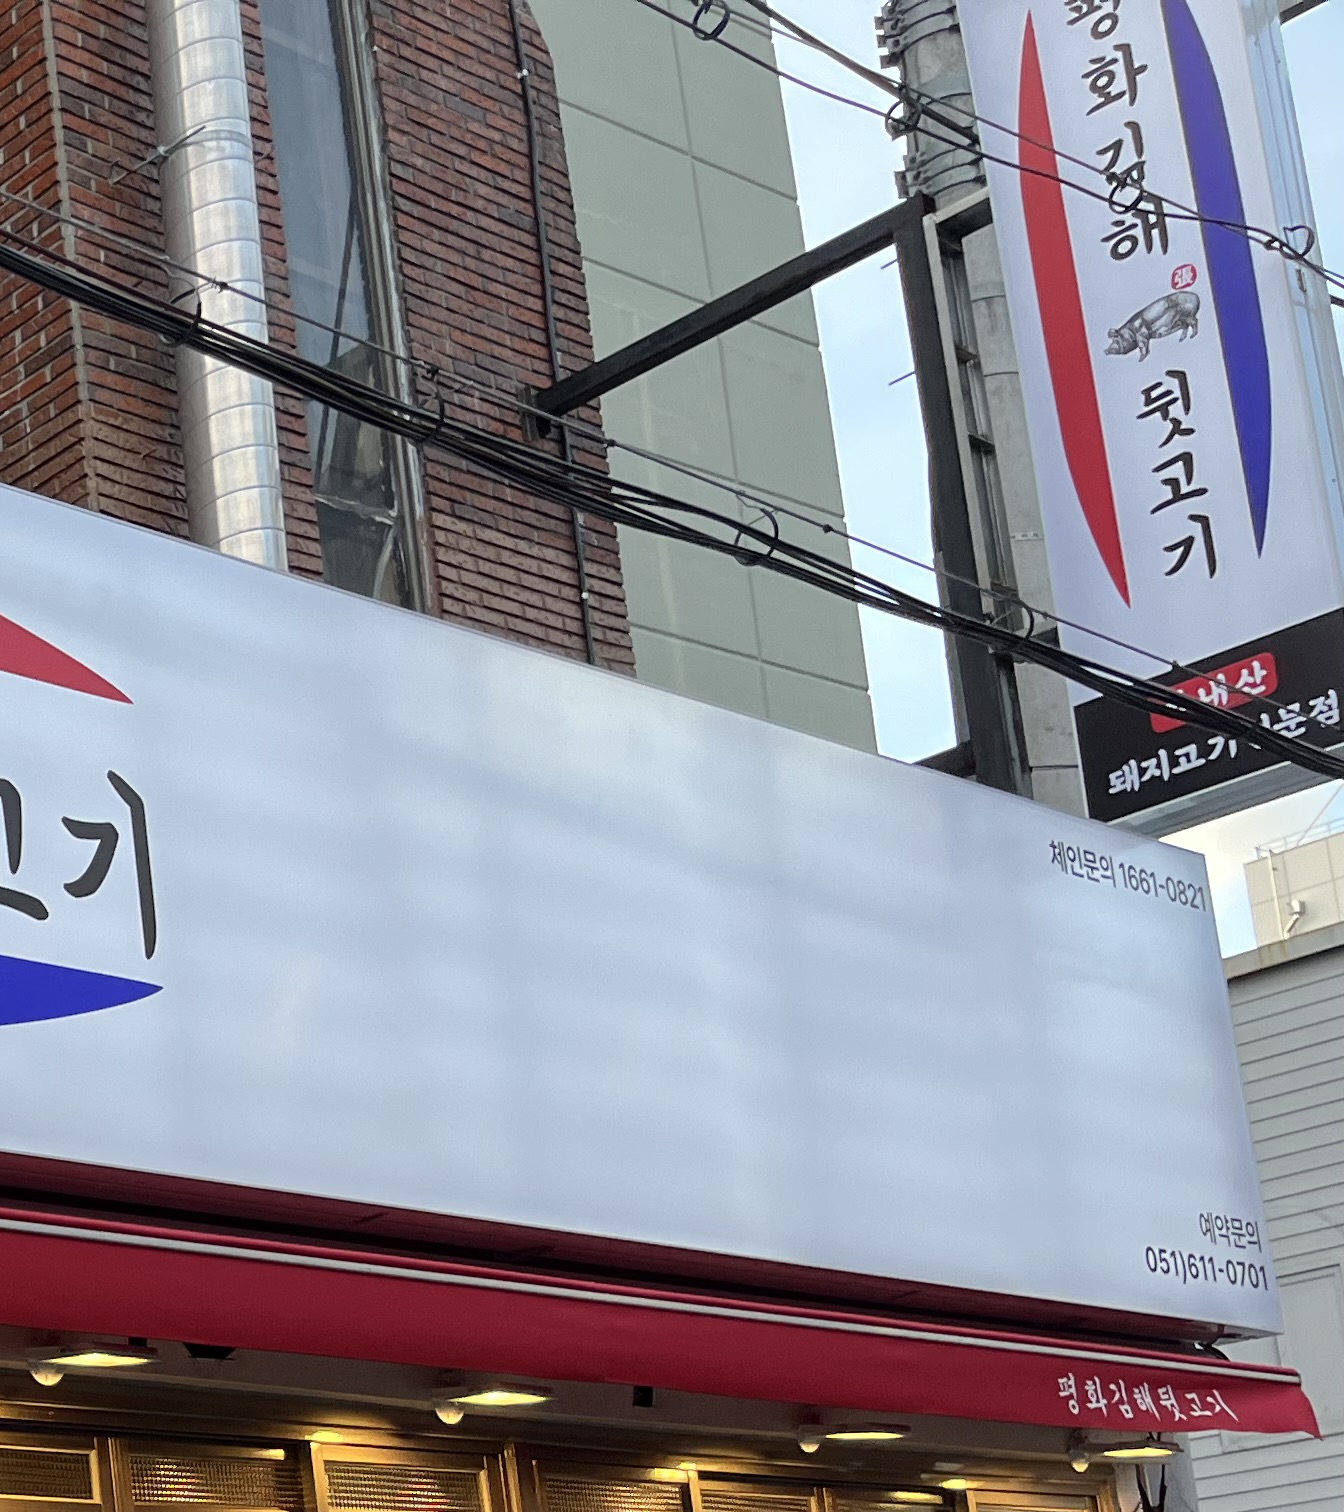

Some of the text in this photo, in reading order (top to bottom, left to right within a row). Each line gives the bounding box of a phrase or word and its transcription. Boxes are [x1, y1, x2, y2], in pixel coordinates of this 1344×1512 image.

[1136, 370, 1217, 579] 뒷고기
[1165, 660, 1267, 712] 내산
[1108, 736, 1238, 794] 돼지고기
[1050, 840, 1207, 911] 체인문의 1661-0821
[1199, 1211, 1262, 1253] 예약문의
[1145, 1246, 1269, 1291] 051)611-0701
[1058, 1372, 1239, 1423] 평화김해뒷고기
